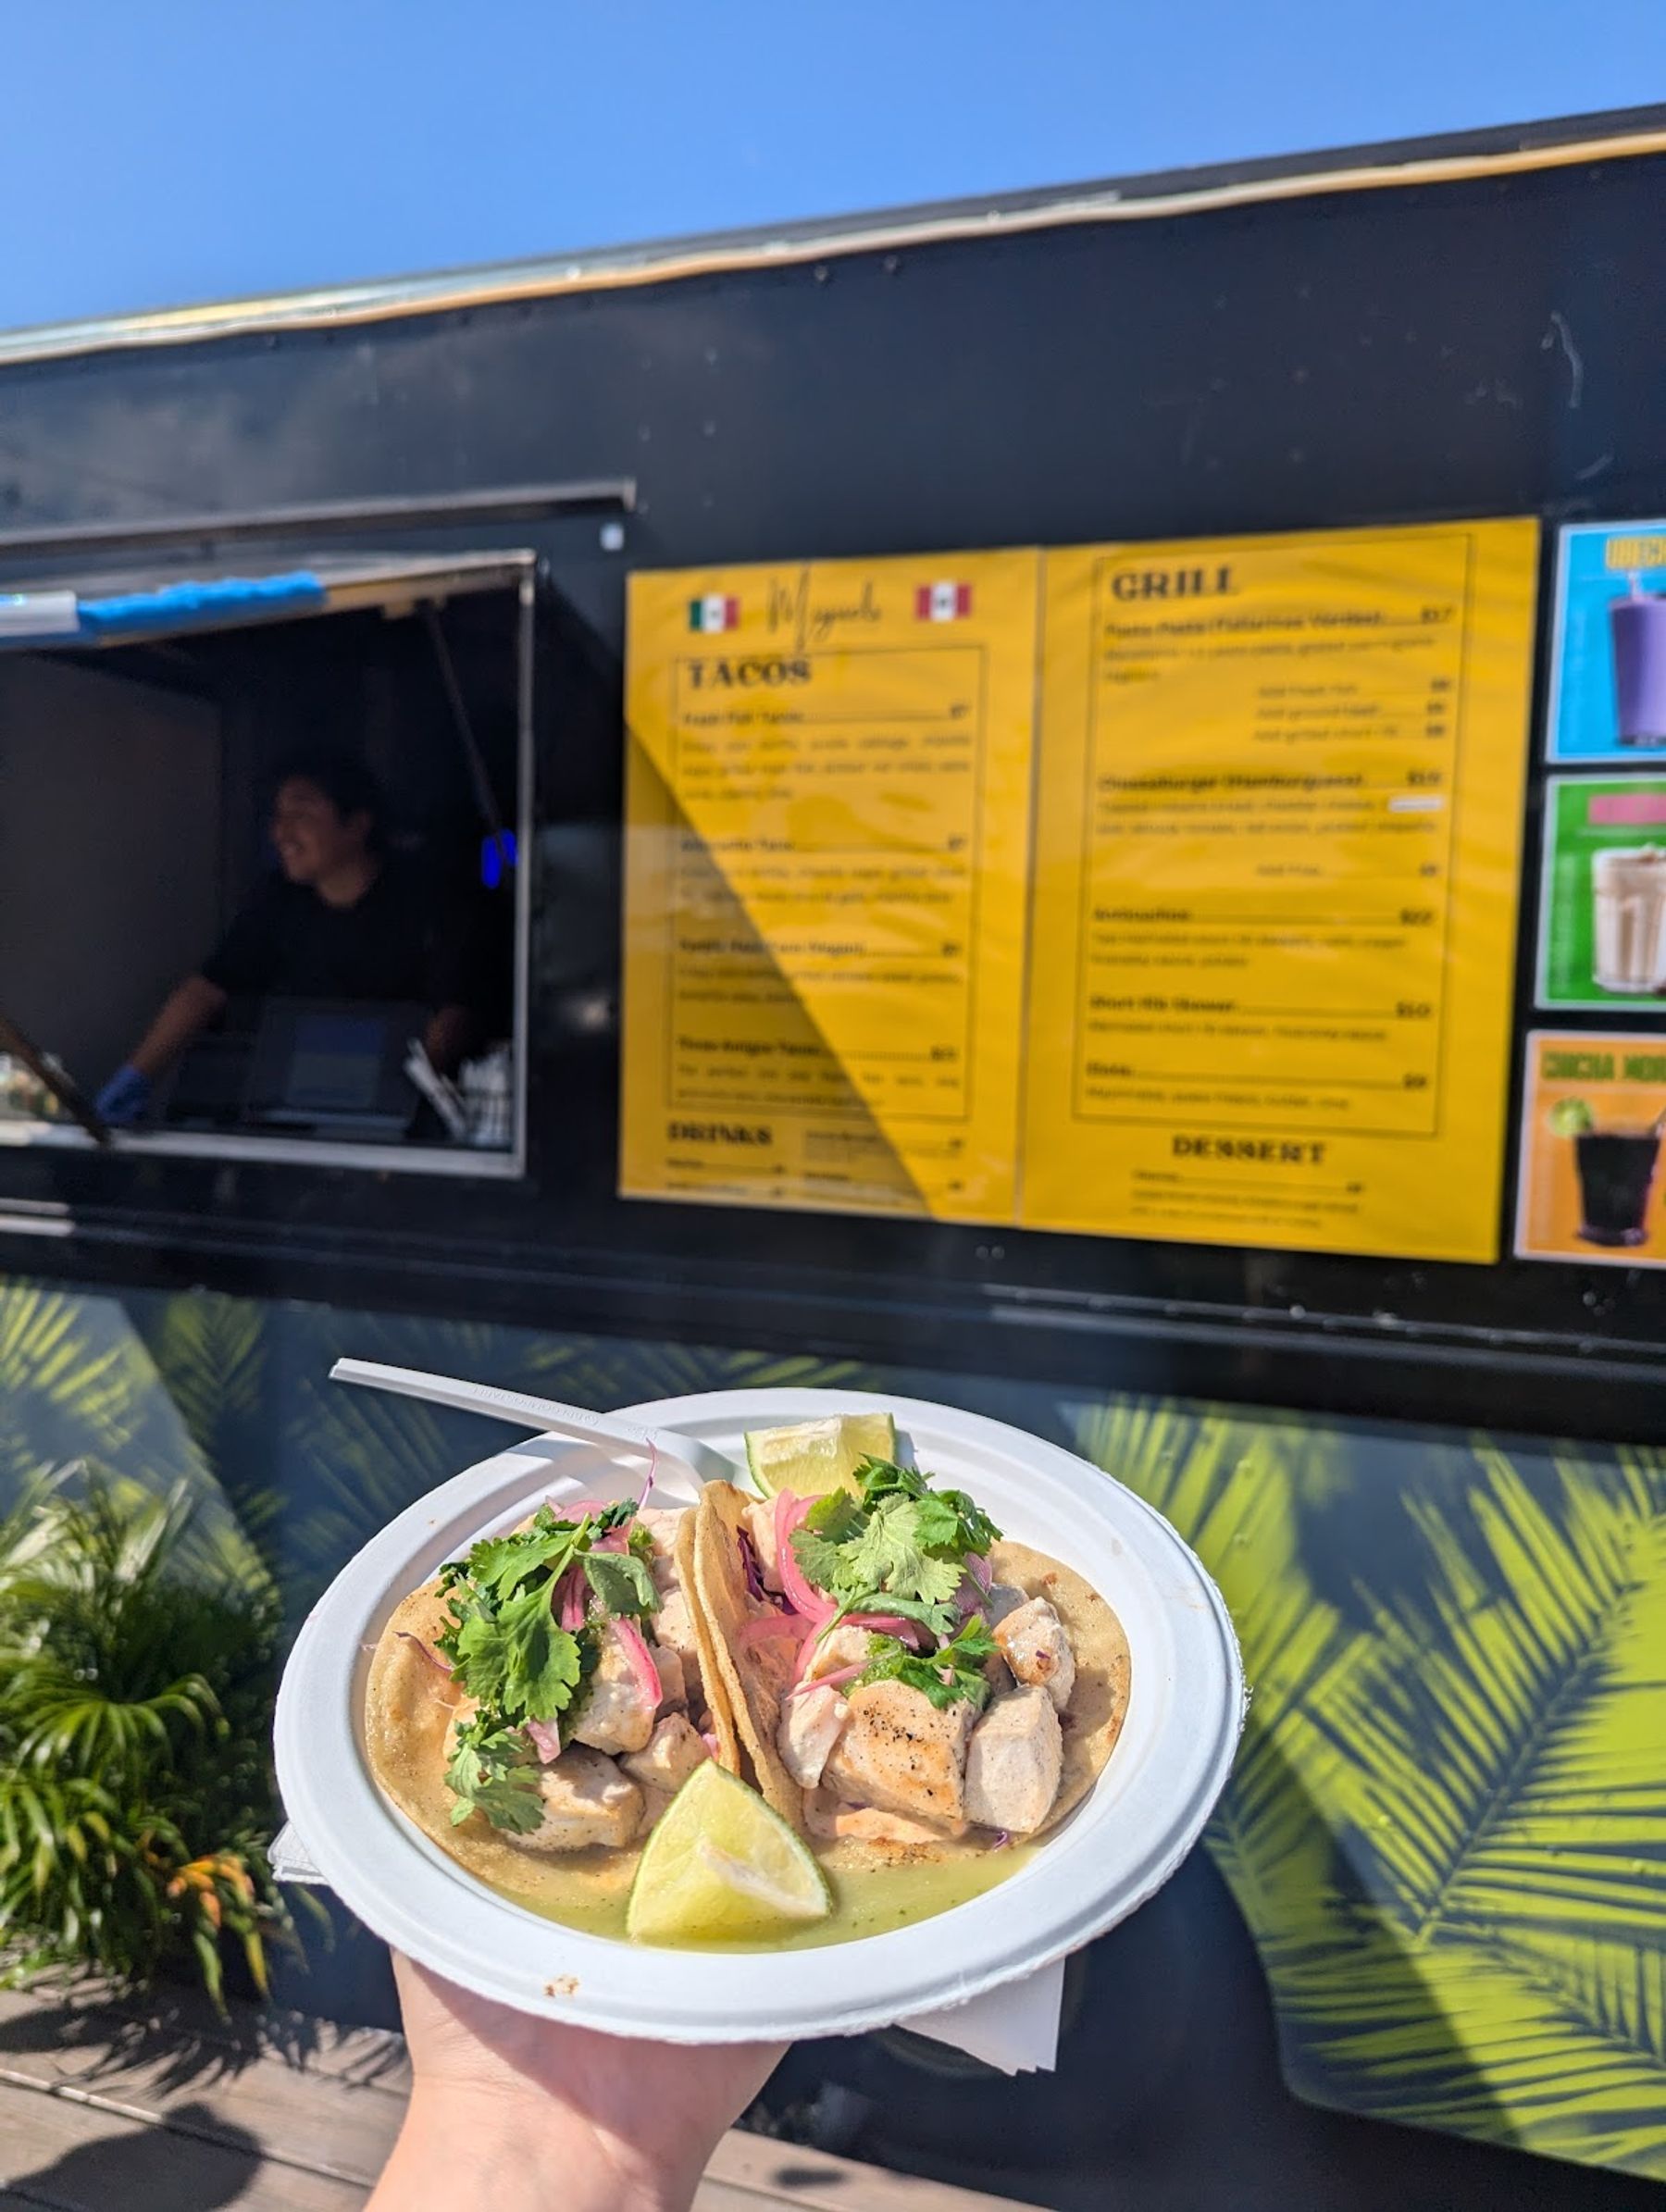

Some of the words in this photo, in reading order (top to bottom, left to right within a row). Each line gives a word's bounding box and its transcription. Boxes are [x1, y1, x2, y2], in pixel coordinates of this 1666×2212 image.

[1113, 565, 1238, 602] GRILL
[689, 658, 811, 690] TACOS
[666, 1120, 774, 1147] DRINKS
[1172, 1135, 1327, 1165] DESSERT
